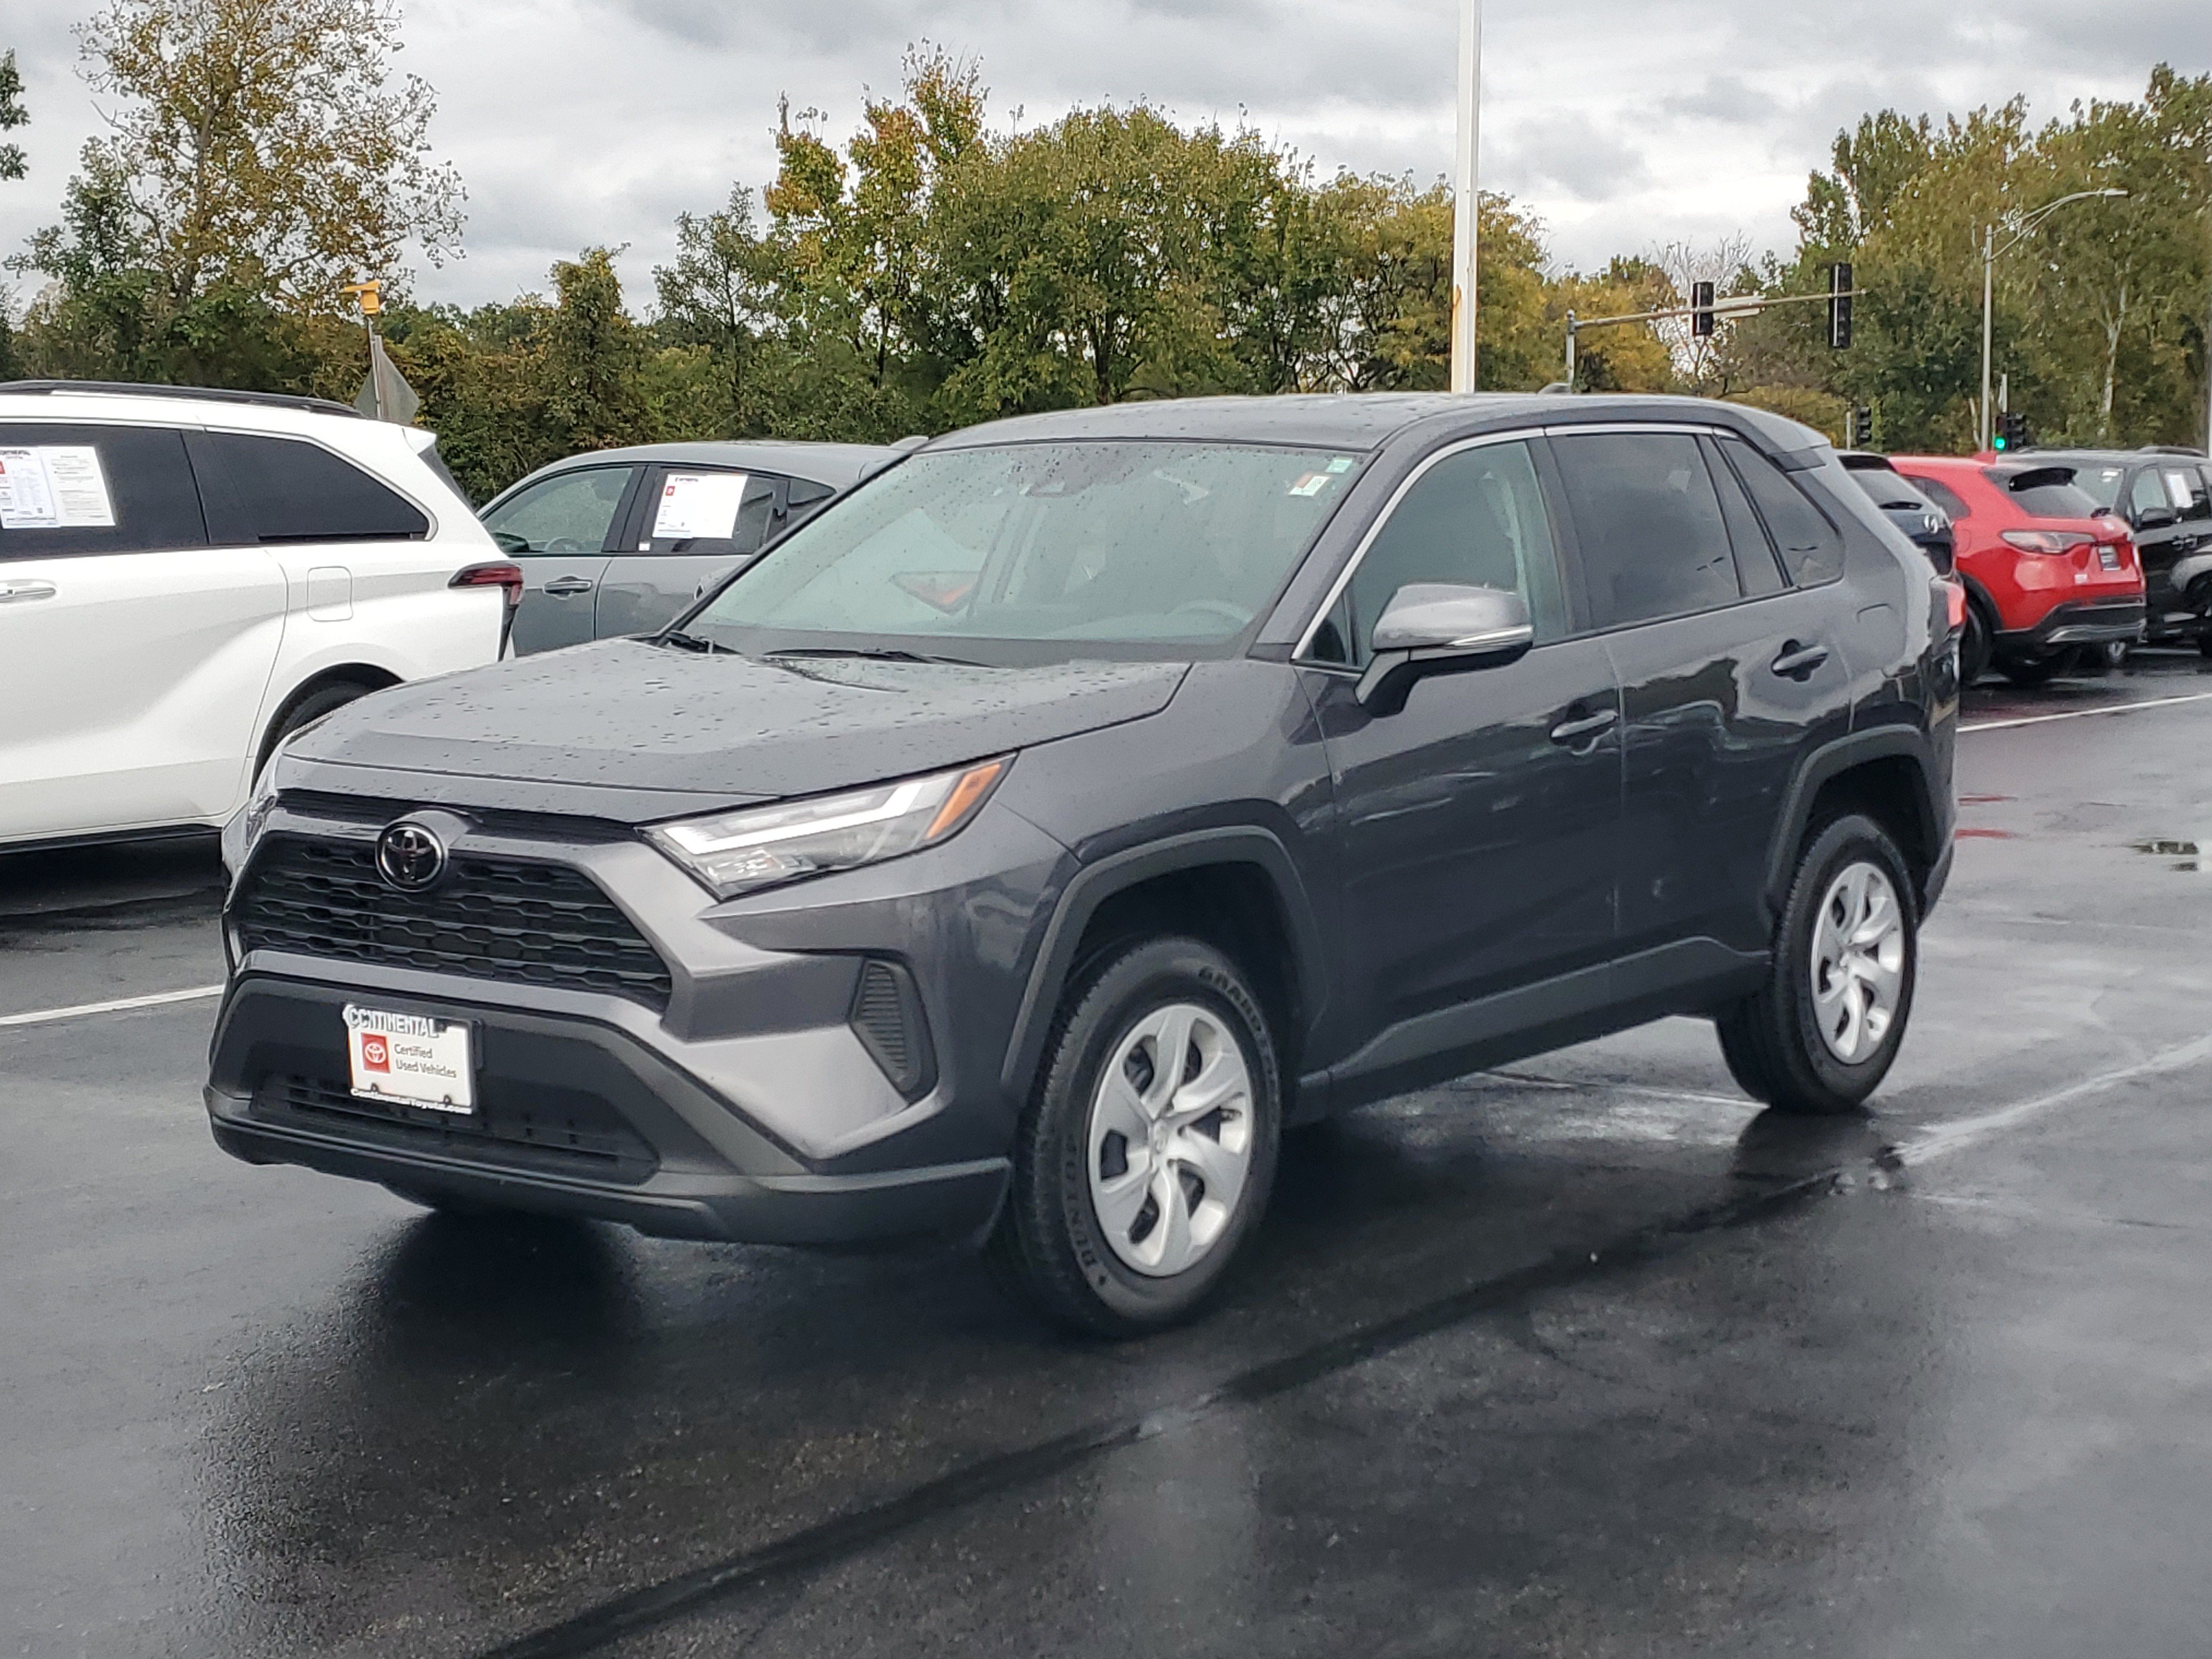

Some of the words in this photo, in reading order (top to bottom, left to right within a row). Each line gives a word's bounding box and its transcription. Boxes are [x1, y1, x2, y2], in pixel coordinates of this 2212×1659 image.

[348, 1007, 439, 1038] CONTINENTAL
[394, 1043, 433, 1059] Certified
[396, 1059, 419, 1072] Used
[419, 1062, 456, 1078] Vehicles
